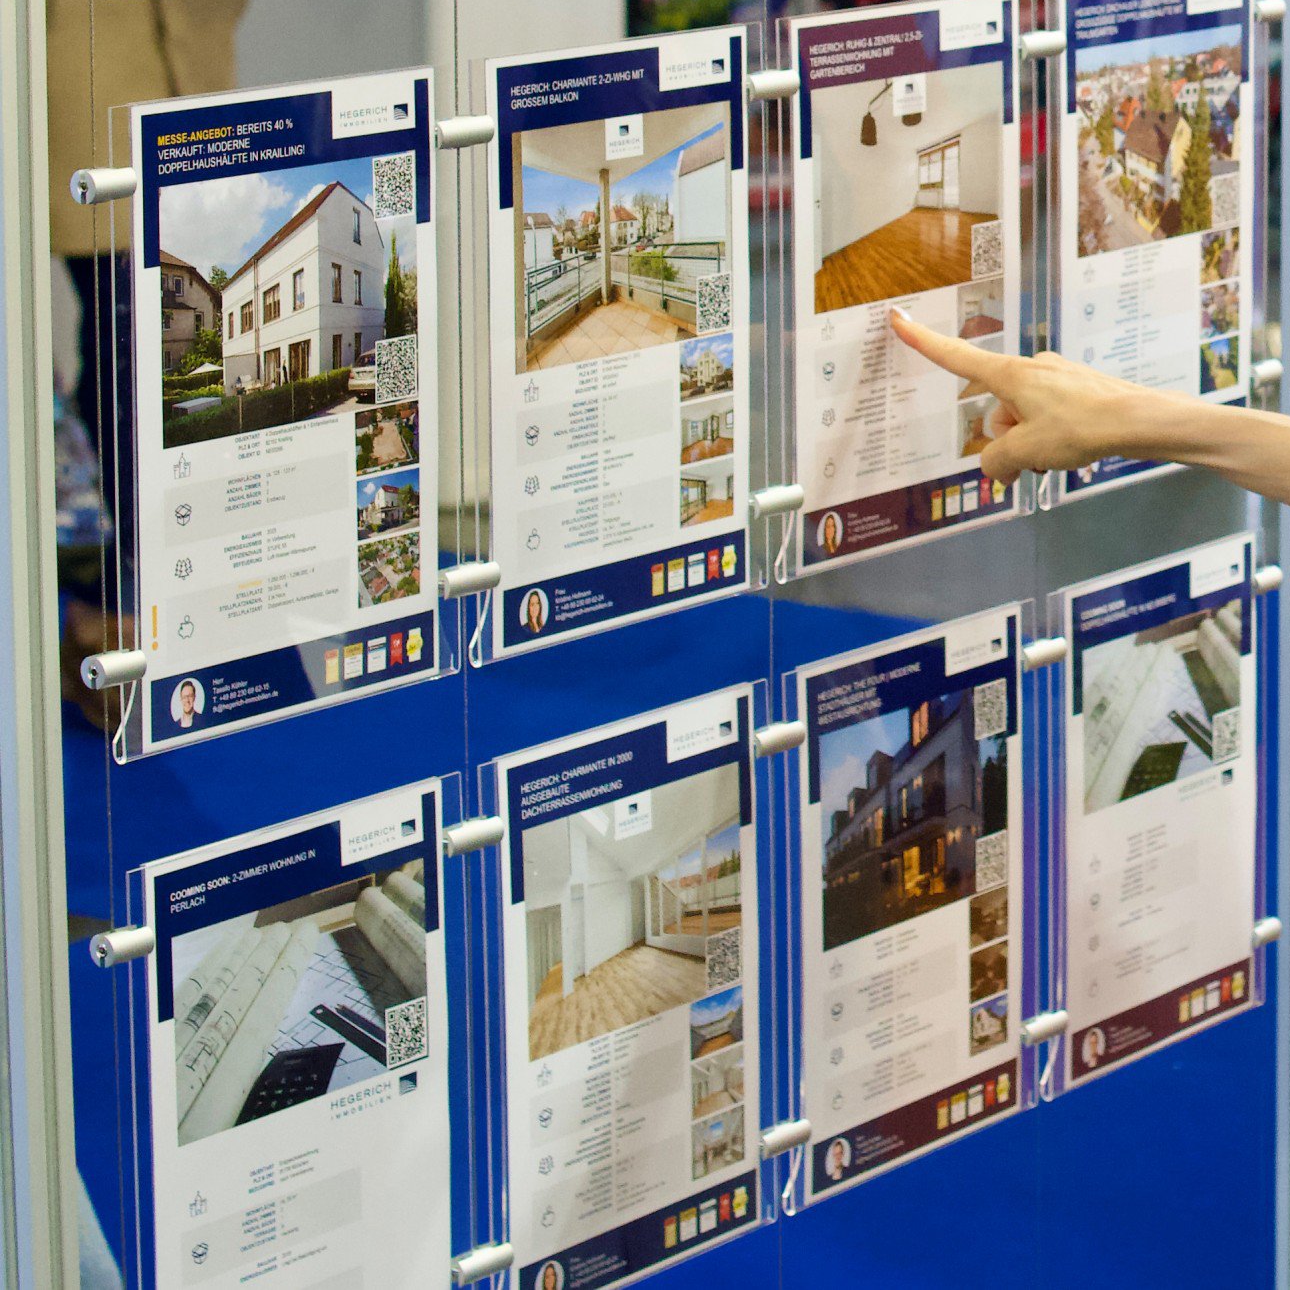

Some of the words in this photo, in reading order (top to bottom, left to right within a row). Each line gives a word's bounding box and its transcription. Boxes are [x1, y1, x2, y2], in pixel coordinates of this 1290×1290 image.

[511, 81, 550, 96] HEGERICH:
[552, 75, 597, 91] CHARMANTE
[599, 71, 630, 84] 2-ZI-WHG
[632, 69, 644, 80] MIT
[340, 106, 387, 119] HEGERICH
[511, 96, 548, 110] GROSSEM
[549, 92, 579, 105] BALKON
[158, 126, 235, 146] MESSE-ANGEBOT:
[237, 121, 272, 135] BEREITS
[274, 120, 285, 131] 40
[286, 118, 293, 129] %
[158, 144, 205, 160] VERKAUFT:
[207, 138, 250, 154] MODERNE
[158, 152, 248, 175] DOPPELHAUSHÄLFTE
[250, 151, 258, 162] IN
[260, 144, 305, 160] KRAILLING!
[521, 773, 560, 794] HEGERICH:
[561, 759, 607, 782] CHARMANTE
[608, 756, 616, 768] IN
[617, 751, 633, 765] 2000
[521, 784, 570, 807] AUSGEBAUTE
[522, 779, 623, 820] DACHTERRASSENWOHNUNG
[349, 825, 395, 845] HEGERICH
[208, 874, 231, 891] SOON:
[232, 863, 268, 883] 2-ZIMMER
[269, 851, 307, 872] WOHNUNG
[308, 849, 315, 861] IN
[170, 895, 205, 914] PERLACH
[331, 1081, 392, 1110] HEGERICH
